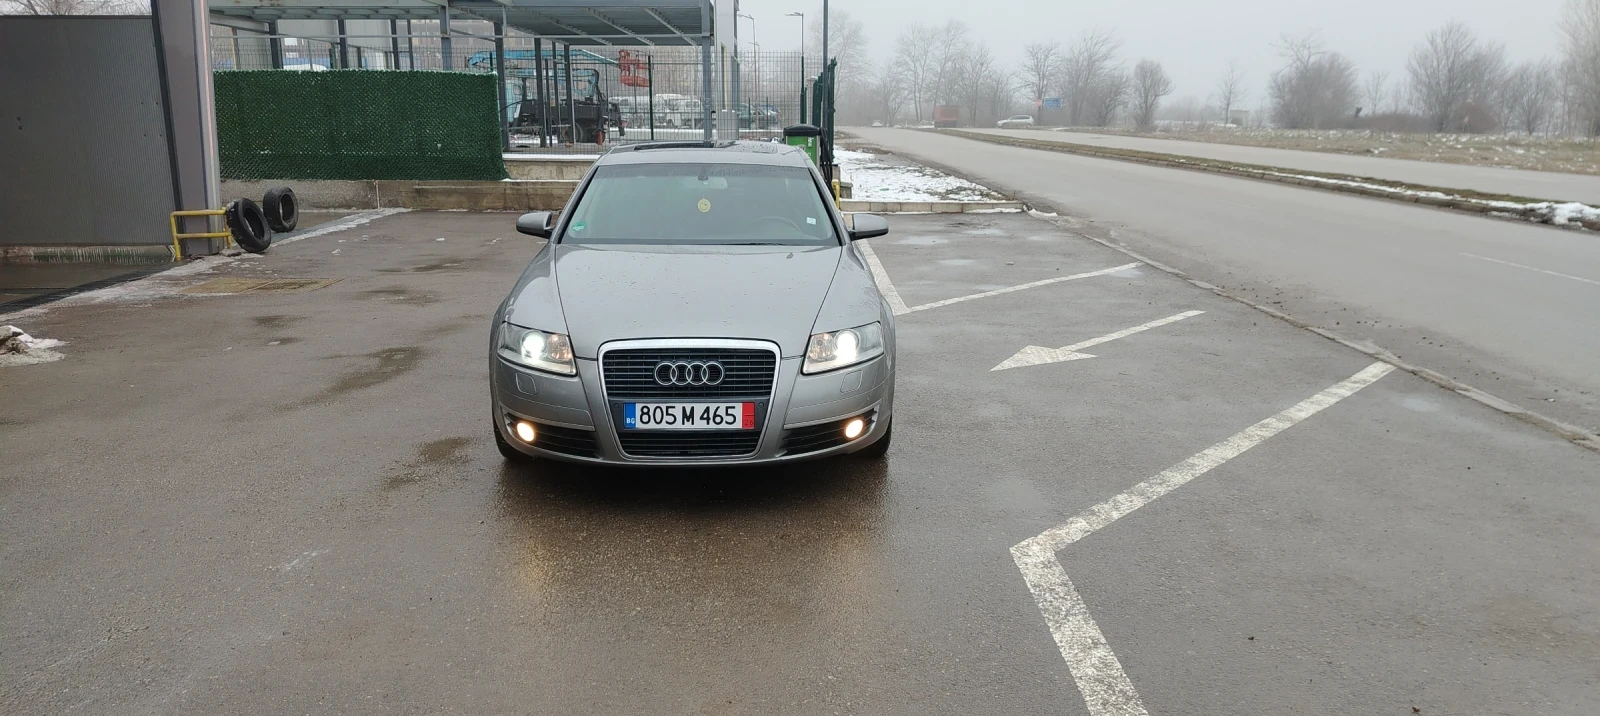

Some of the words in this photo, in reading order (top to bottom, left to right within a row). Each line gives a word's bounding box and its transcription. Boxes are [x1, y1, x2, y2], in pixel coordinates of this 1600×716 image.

[640, 405, 677, 425] 805
[682, 406, 695, 425] M
[699, 406, 737, 425] 465
